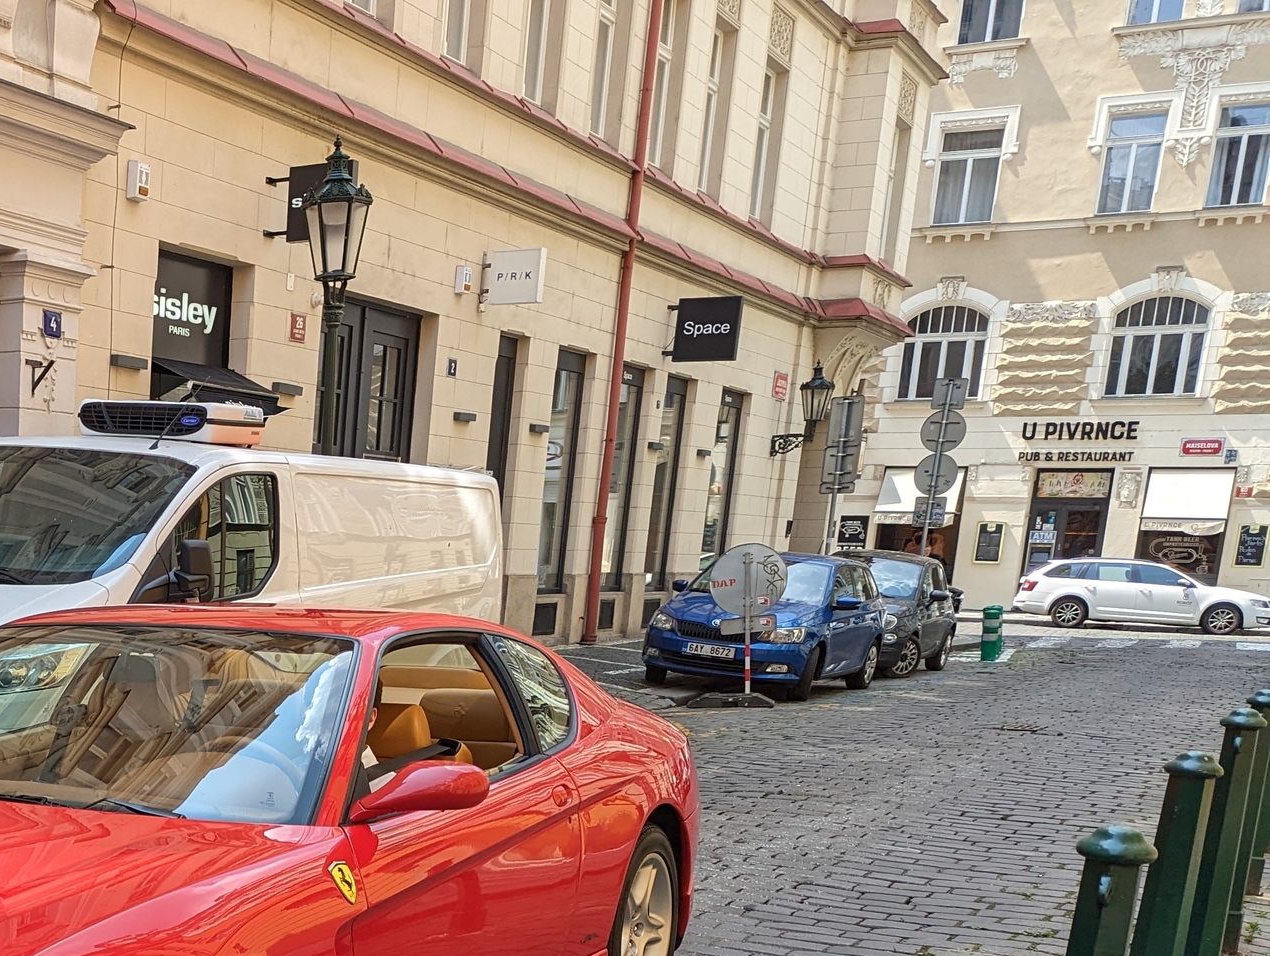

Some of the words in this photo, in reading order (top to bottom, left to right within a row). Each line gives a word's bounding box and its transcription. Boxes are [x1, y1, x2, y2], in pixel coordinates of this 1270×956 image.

[50, 316, 57, 332] 4
[296, 316, 304, 328] 26
[168, 325, 190, 337] PARIS
[683, 321, 730, 338] Space
[450, 362, 455, 373] 2
[1022, 422, 1038, 440] U
[1044, 421, 1140, 440] PIVRNCE
[1018, 452, 1040, 461] PUB
[1045, 452, 1054, 461] &
[1058, 452, 1134, 462] RESTAURANT
[689, 644, 704, 653] 6AY
[710, 647, 731, 656] 8672
